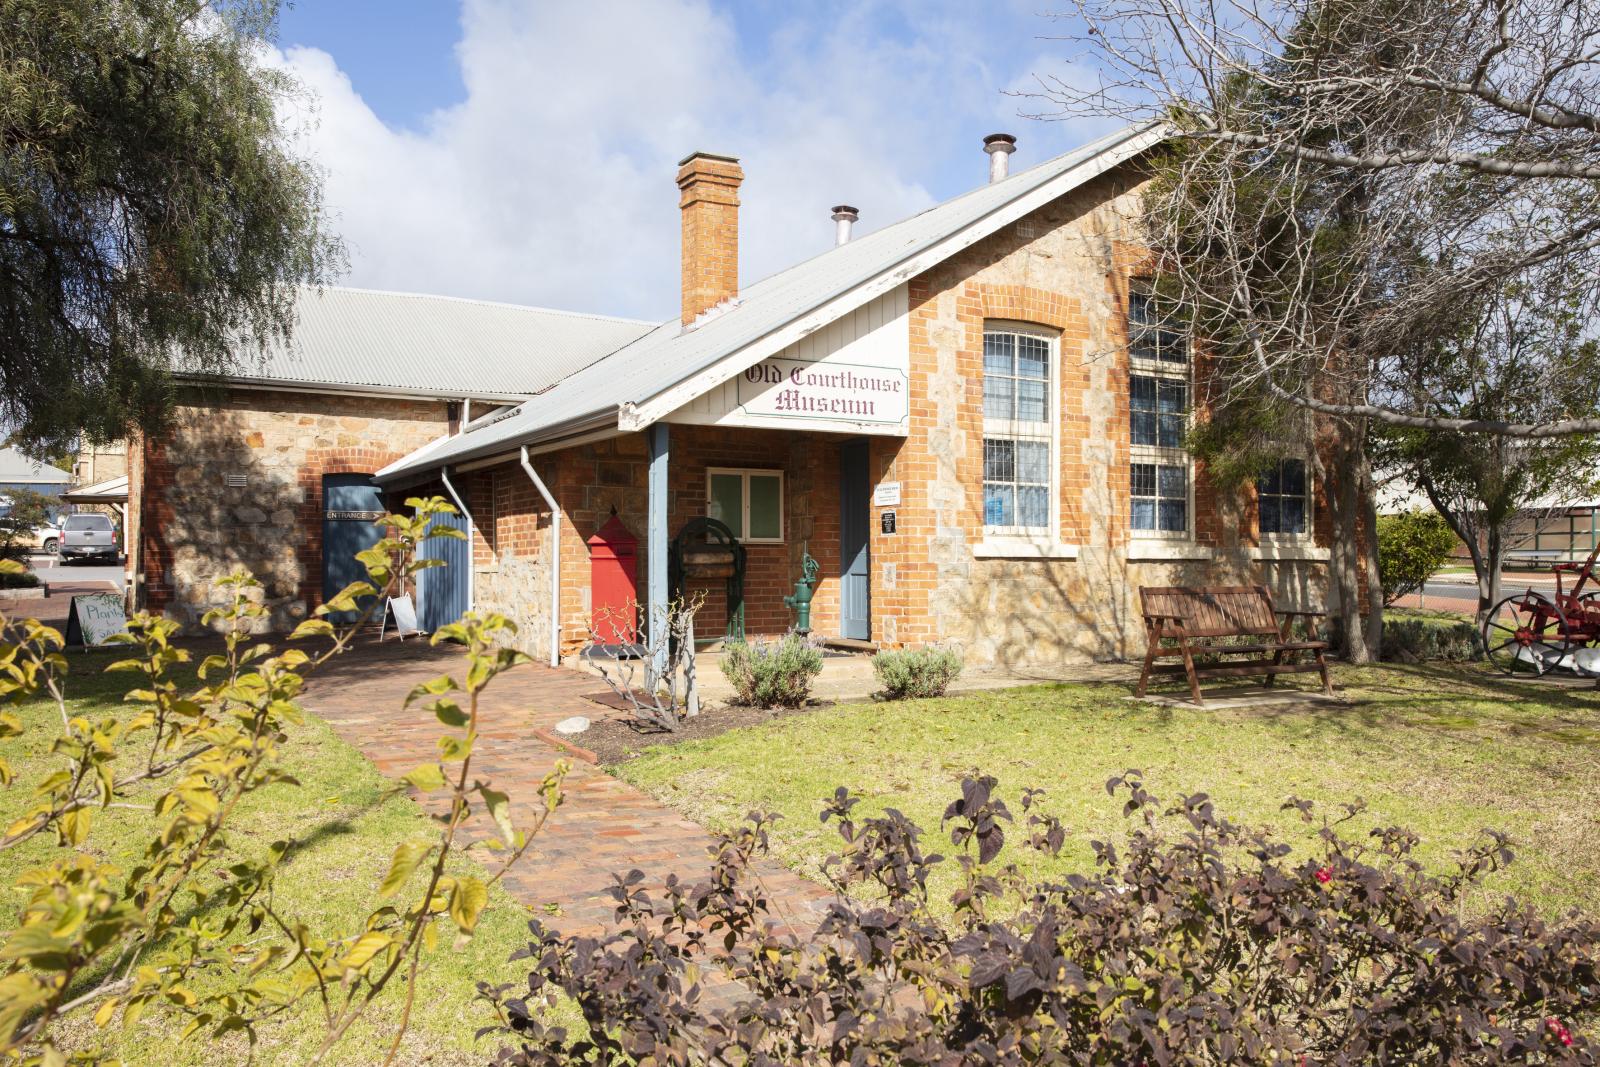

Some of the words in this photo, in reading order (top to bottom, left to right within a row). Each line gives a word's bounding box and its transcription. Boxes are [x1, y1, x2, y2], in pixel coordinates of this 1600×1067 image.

[745, 363, 782, 384] Old
[790, 366, 901, 394] Courthouse
[775, 389, 875, 416] Museum
[86, 605, 125, 619] Plants
